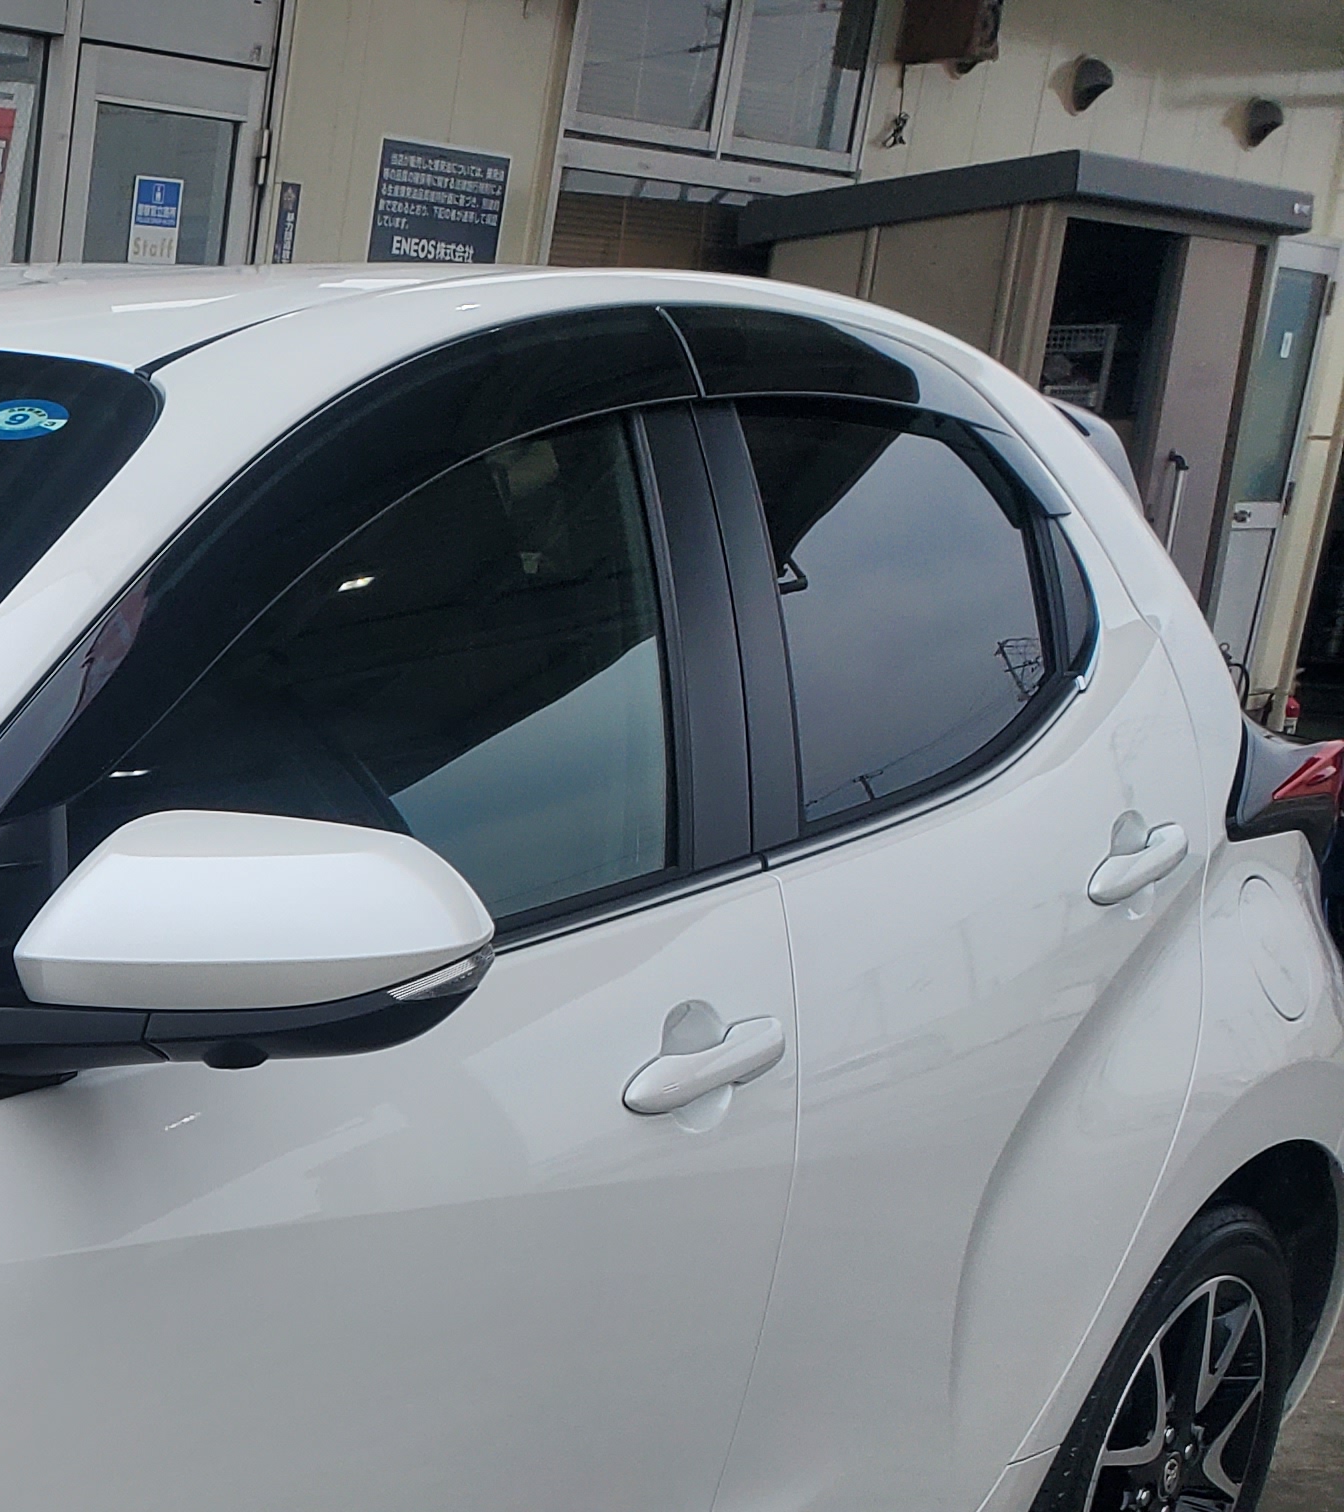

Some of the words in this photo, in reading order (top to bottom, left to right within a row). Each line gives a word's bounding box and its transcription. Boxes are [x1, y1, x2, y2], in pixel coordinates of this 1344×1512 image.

[132, 236, 174, 259] Staff
[391, 235, 474, 263] ENEOS株式会社
